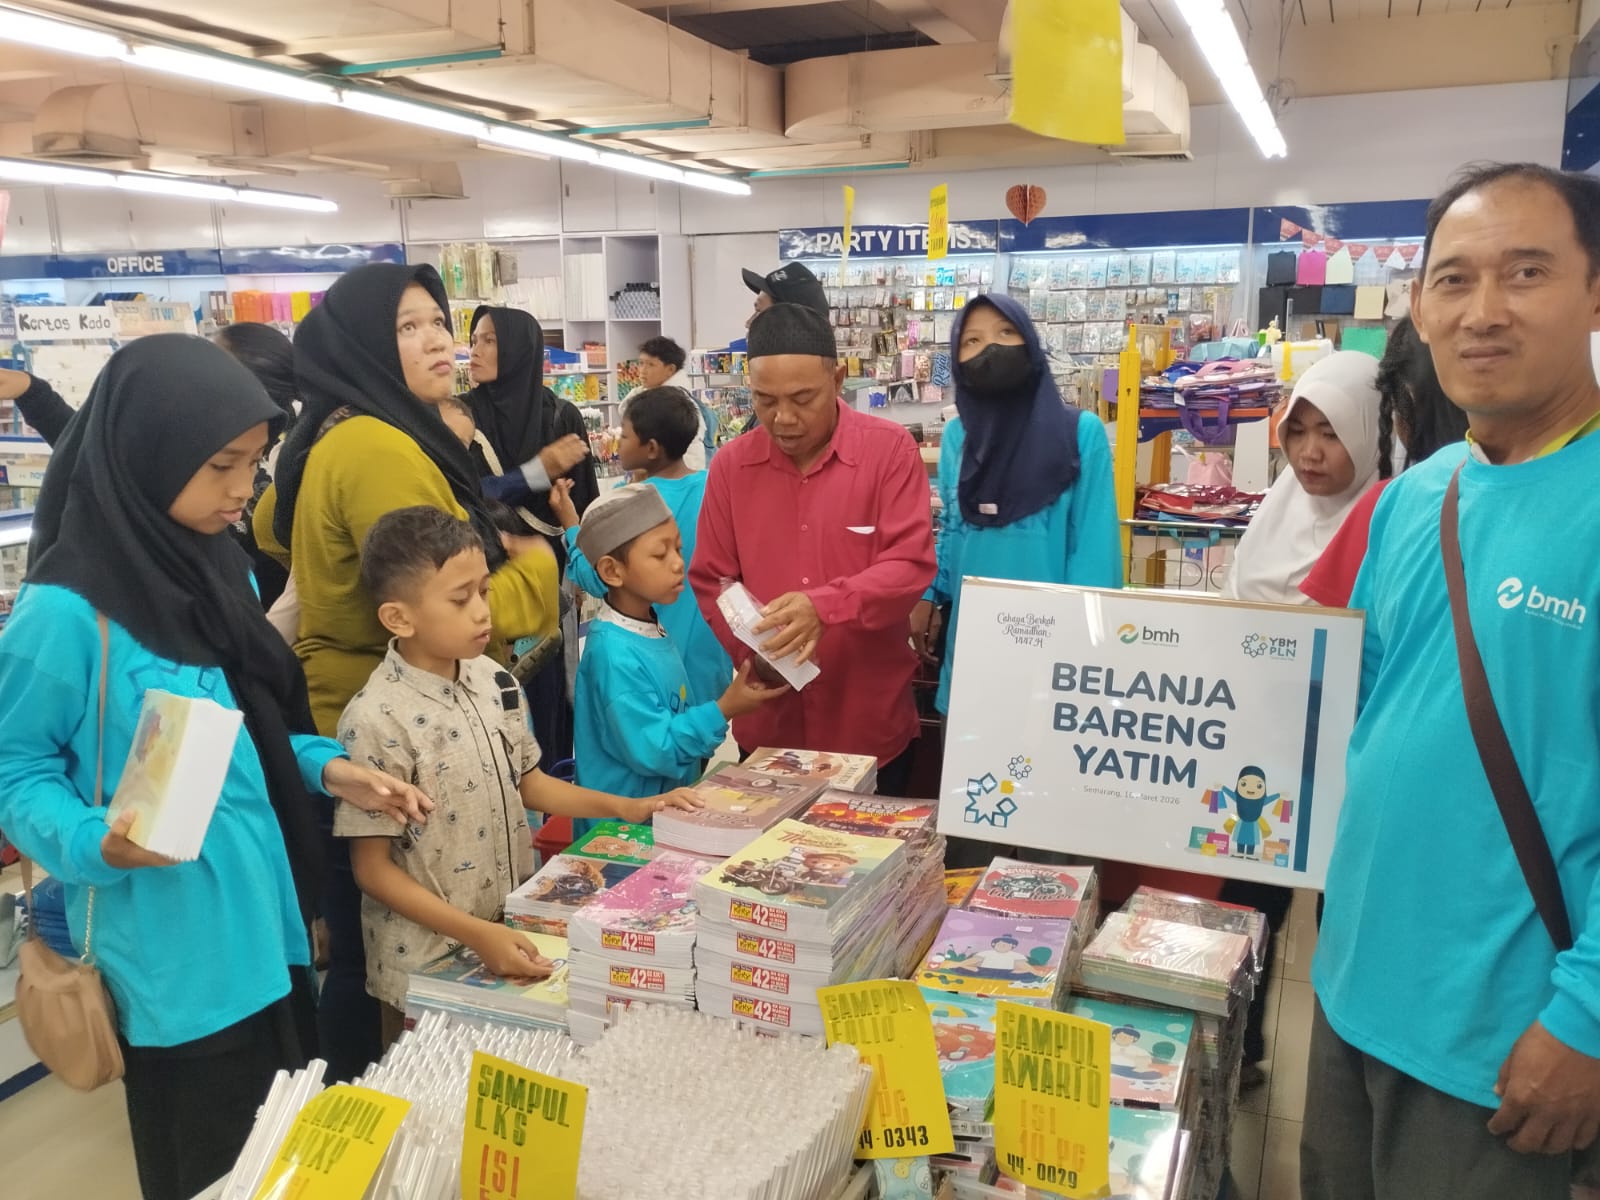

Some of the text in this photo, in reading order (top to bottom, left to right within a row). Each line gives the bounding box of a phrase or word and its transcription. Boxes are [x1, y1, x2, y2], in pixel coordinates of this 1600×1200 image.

[816, 229, 893, 253] PARTY
[107, 255, 164, 274] OFFICE
[79, 313, 111, 330] Kado
[1526, 585, 1586, 623] bmh
[997, 612, 1055, 627] Cahaya Berkah
[1002, 624, 1052, 637] Ramadhan
[1142, 626, 1180, 644] bmh
[1269, 637, 1297, 648] YBM
[1269, 647, 1297, 658] PLN
[1051, 661, 1236, 711] BELANJA
[1053, 702, 1226, 751] BARENG
[1073, 743, 1198, 789] YATIM
[752, 904, 769, 926] 42
[622, 932, 637, 952] 42
[759, 939, 776, 960] 42
[631, 968, 647, 989] 42
[753, 968, 770, 990] 42
[754, 1000, 772, 1023] 42
[825, 986, 912, 1021] SAMPUL
[831, 1014, 895, 1045] FOLIO
[1002, 1010, 1099, 1069] SAMPUL
[1002, 1048, 1101, 1109] KWARTO
[478, 1063, 570, 1128] SAMPUL
[1020, 1099, 1056, 1135] ISI
[480, 1143, 520, 1198] ISI
